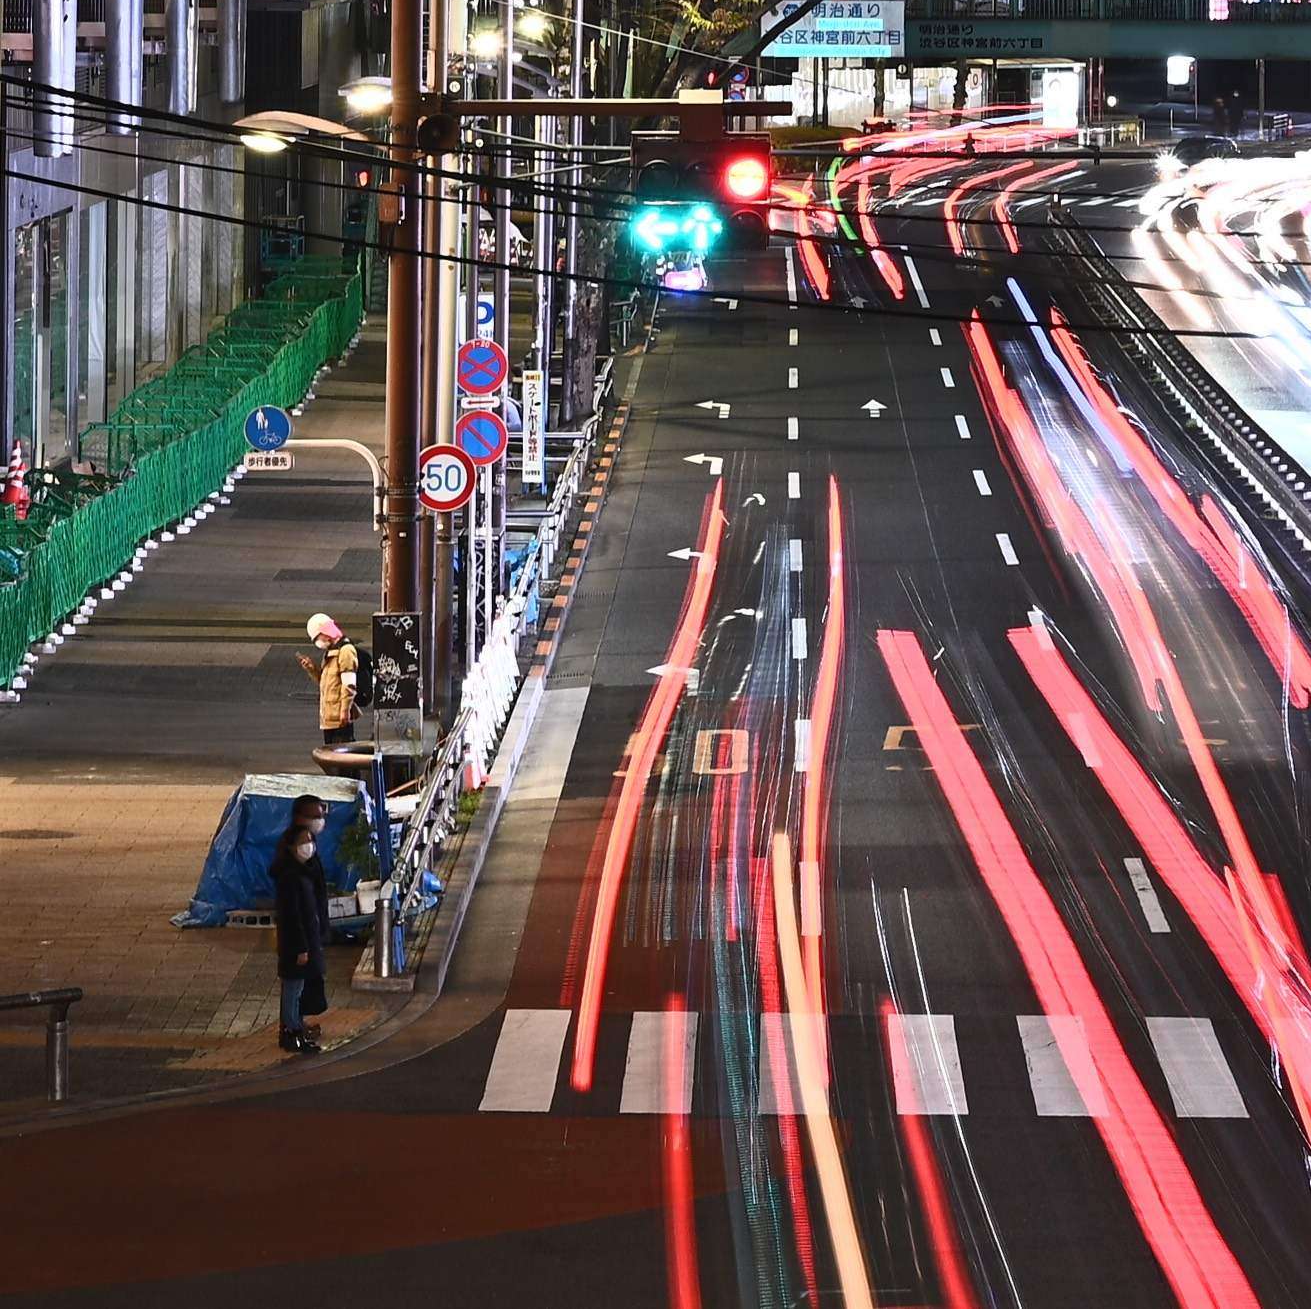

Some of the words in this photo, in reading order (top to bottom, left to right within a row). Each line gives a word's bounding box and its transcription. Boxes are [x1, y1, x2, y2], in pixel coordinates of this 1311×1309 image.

[811, 2, 881, 19] 明治通り
[919, 24, 975, 36] 明治通り
[768, 30, 901, 46] 谷区神宮前六丁目
[919, 37, 1044, 49] 渋谷区神宮前六丁目
[247, 455, 288, 468] 歩行者優先
[425, 463, 463, 493] 50
